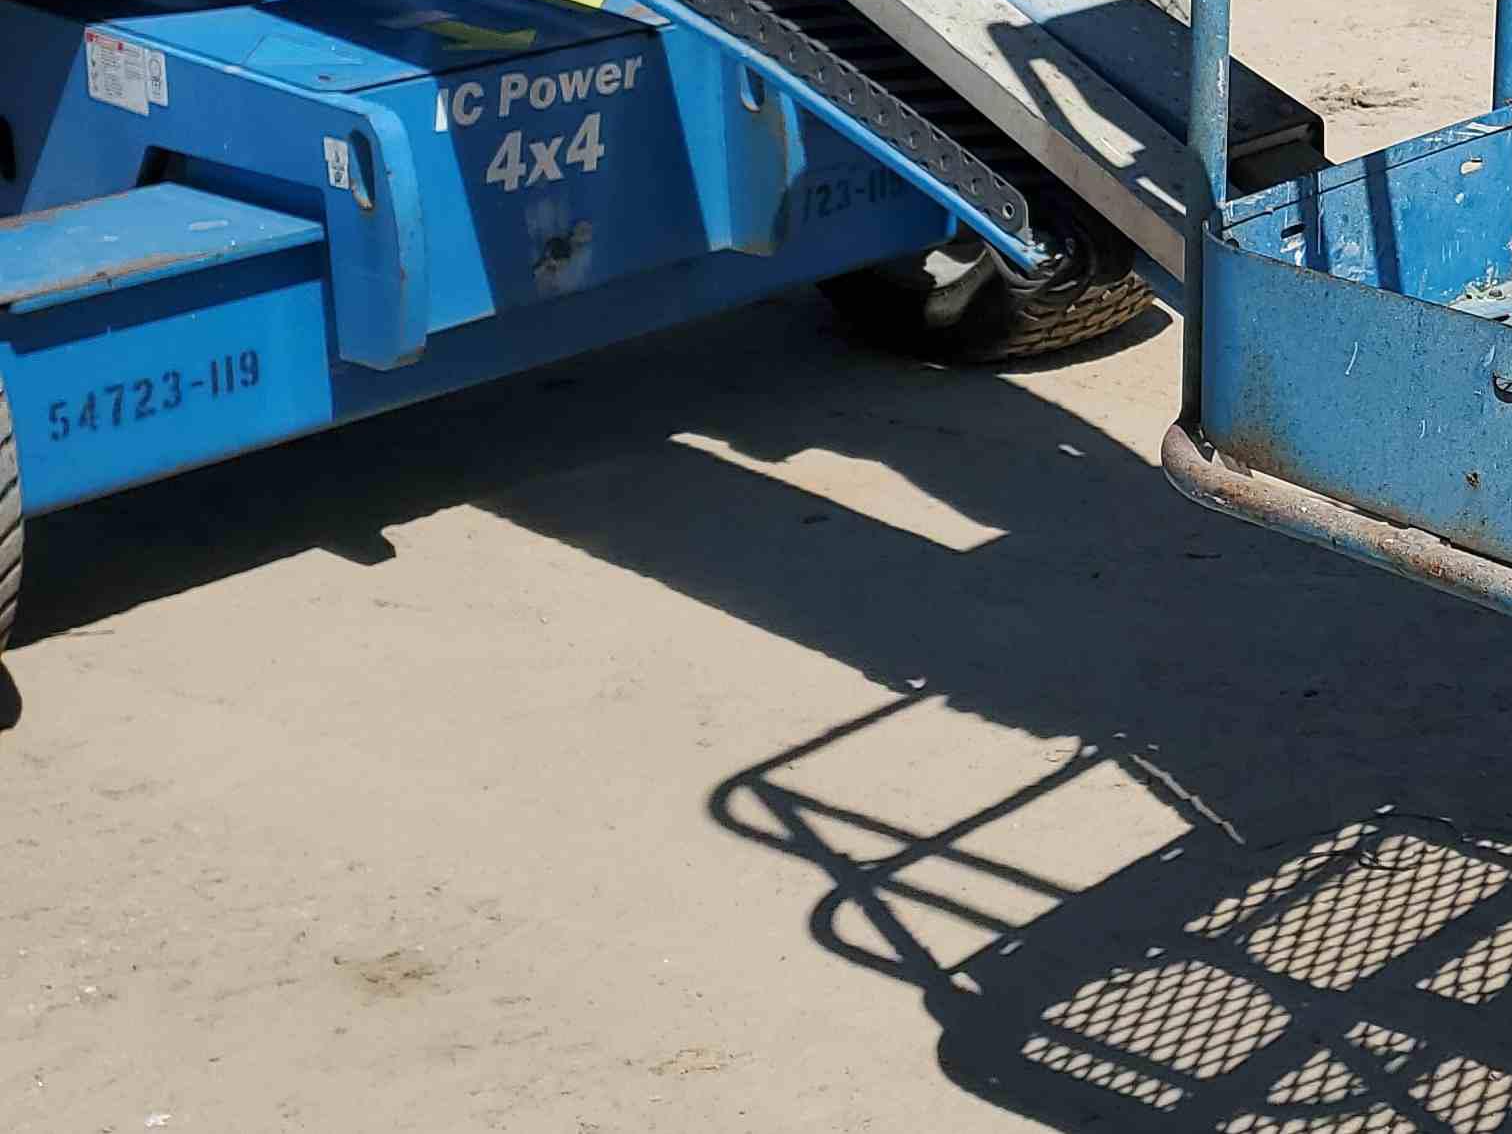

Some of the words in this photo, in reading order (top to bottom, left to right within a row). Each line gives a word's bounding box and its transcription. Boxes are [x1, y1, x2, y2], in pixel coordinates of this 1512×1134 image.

[433, 82, 485, 132] IC
[498, 55, 643, 117] Power
[485, 111, 605, 192] 4x4
[48, 348, 260, 443] 54723-119
